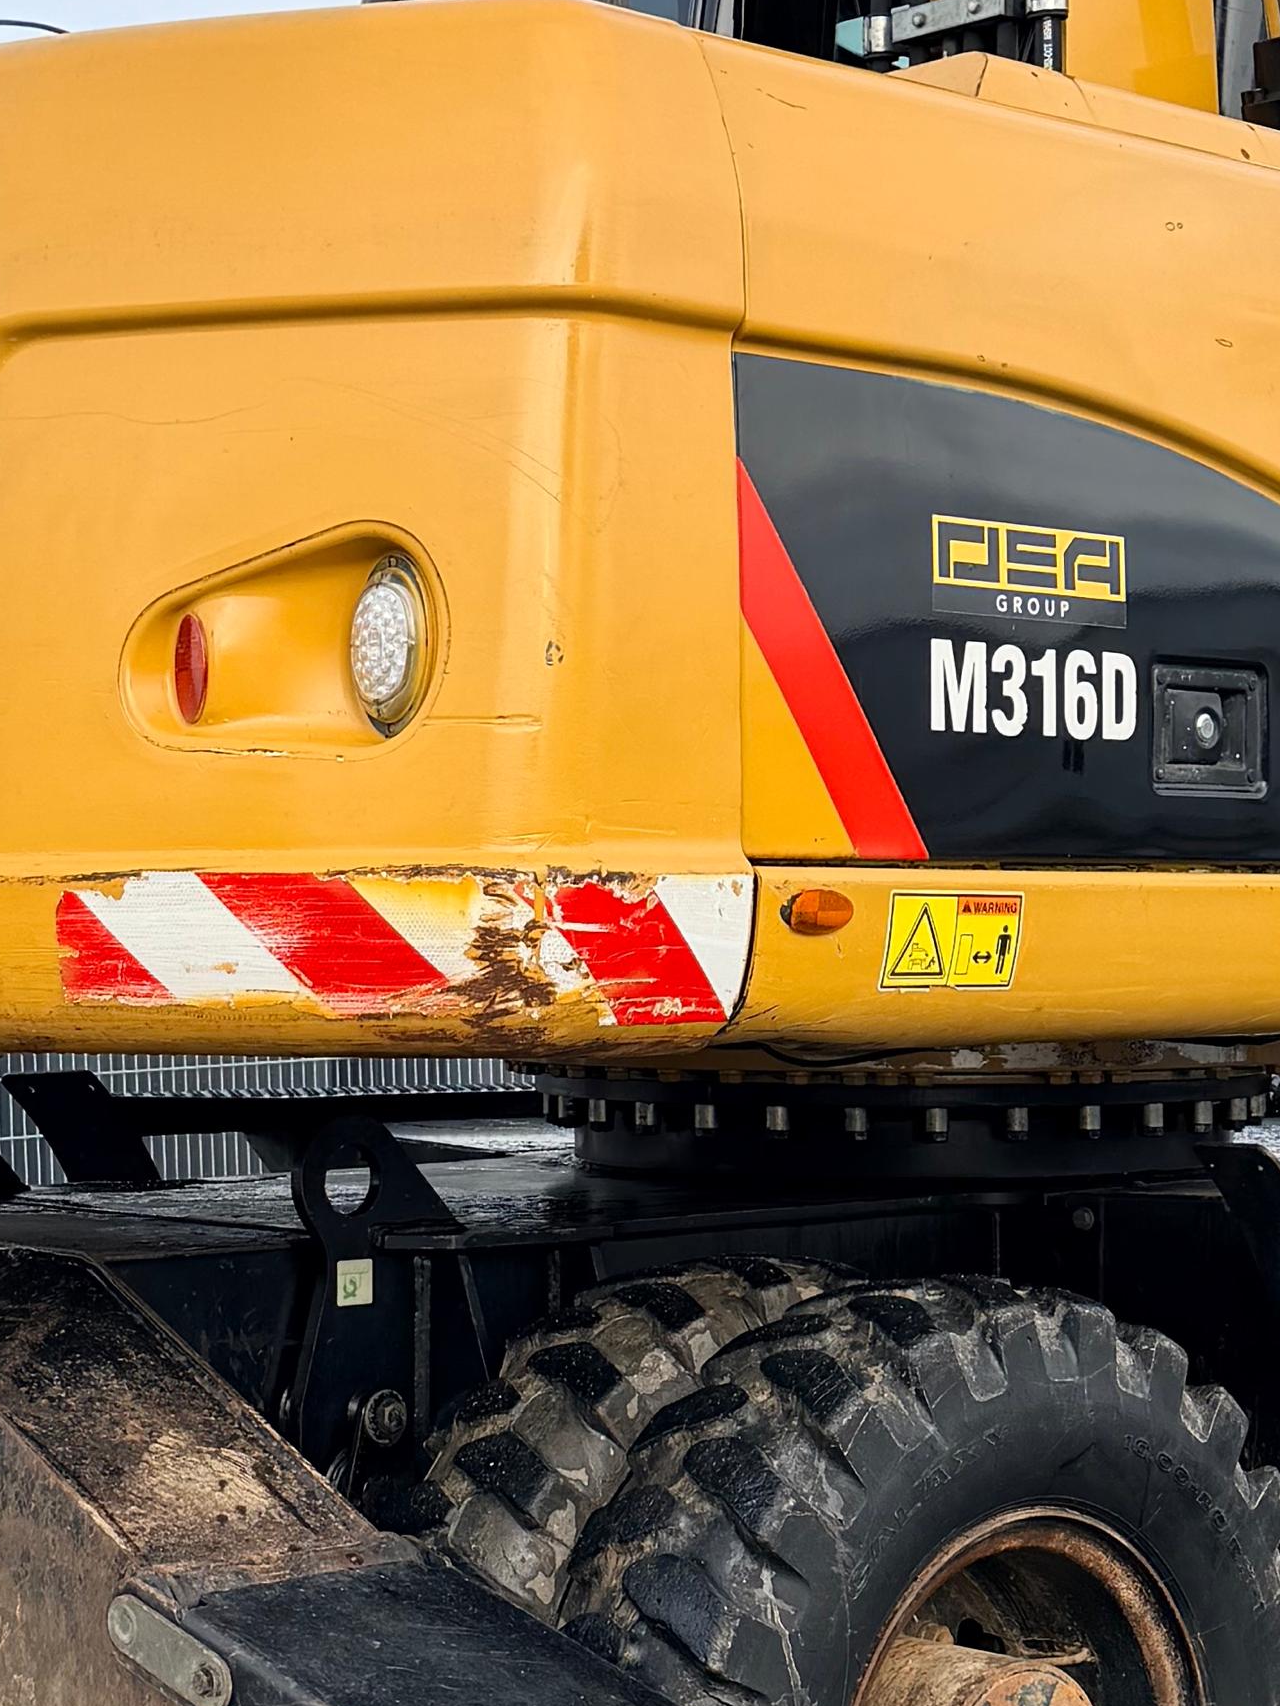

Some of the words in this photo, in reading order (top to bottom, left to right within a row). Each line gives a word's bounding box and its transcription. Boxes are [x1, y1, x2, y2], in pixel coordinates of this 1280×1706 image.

[995, 594, 1071, 618] GROUP
[930, 637, 1138, 741] M316D
[972, 901, 1018, 914] WARNING
